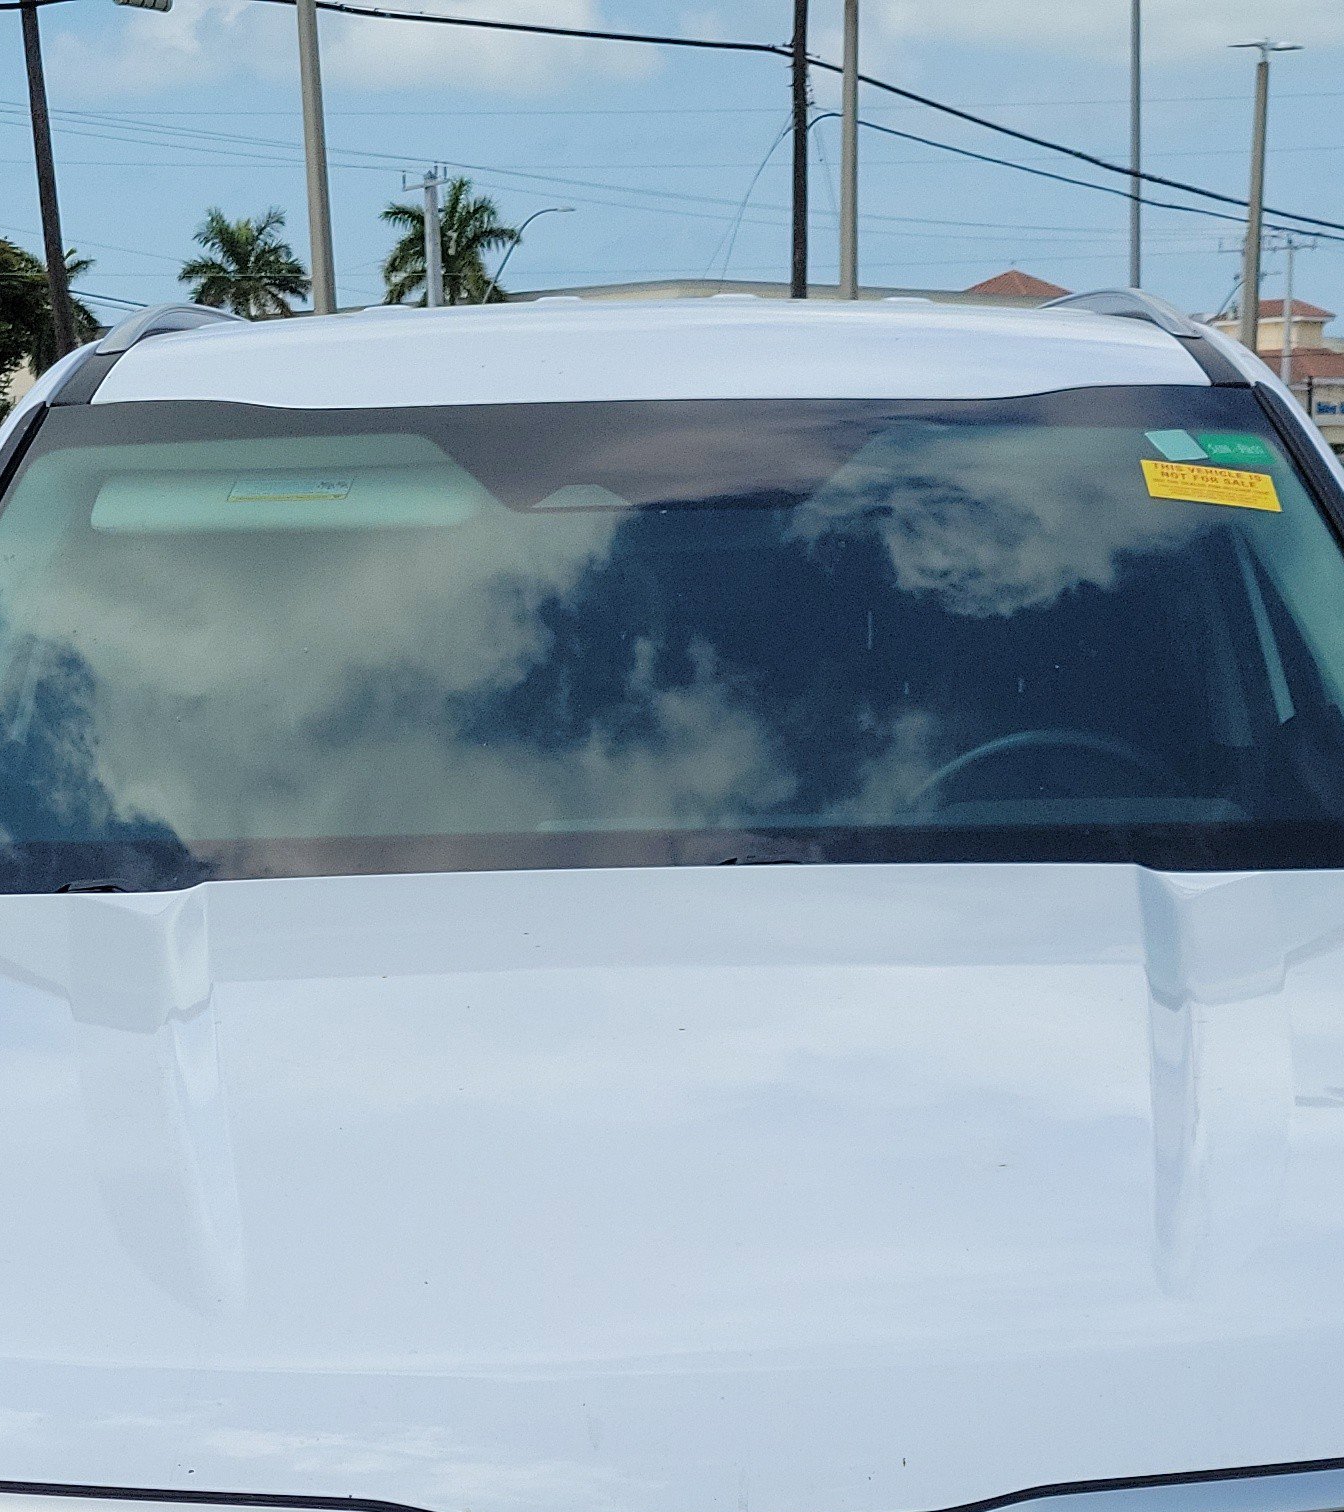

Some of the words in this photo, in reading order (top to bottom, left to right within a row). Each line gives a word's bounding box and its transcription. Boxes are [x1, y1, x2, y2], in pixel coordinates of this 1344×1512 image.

[1153, 462, 1183, 472] THIS
[1188, 466, 1243, 480] VEHICLE
[1248, 473, 1263, 483] IS
[1161, 471, 1187, 480] NOT
[1193, 474, 1219, 484] FOR
[1223, 478, 1257, 489] SALE
